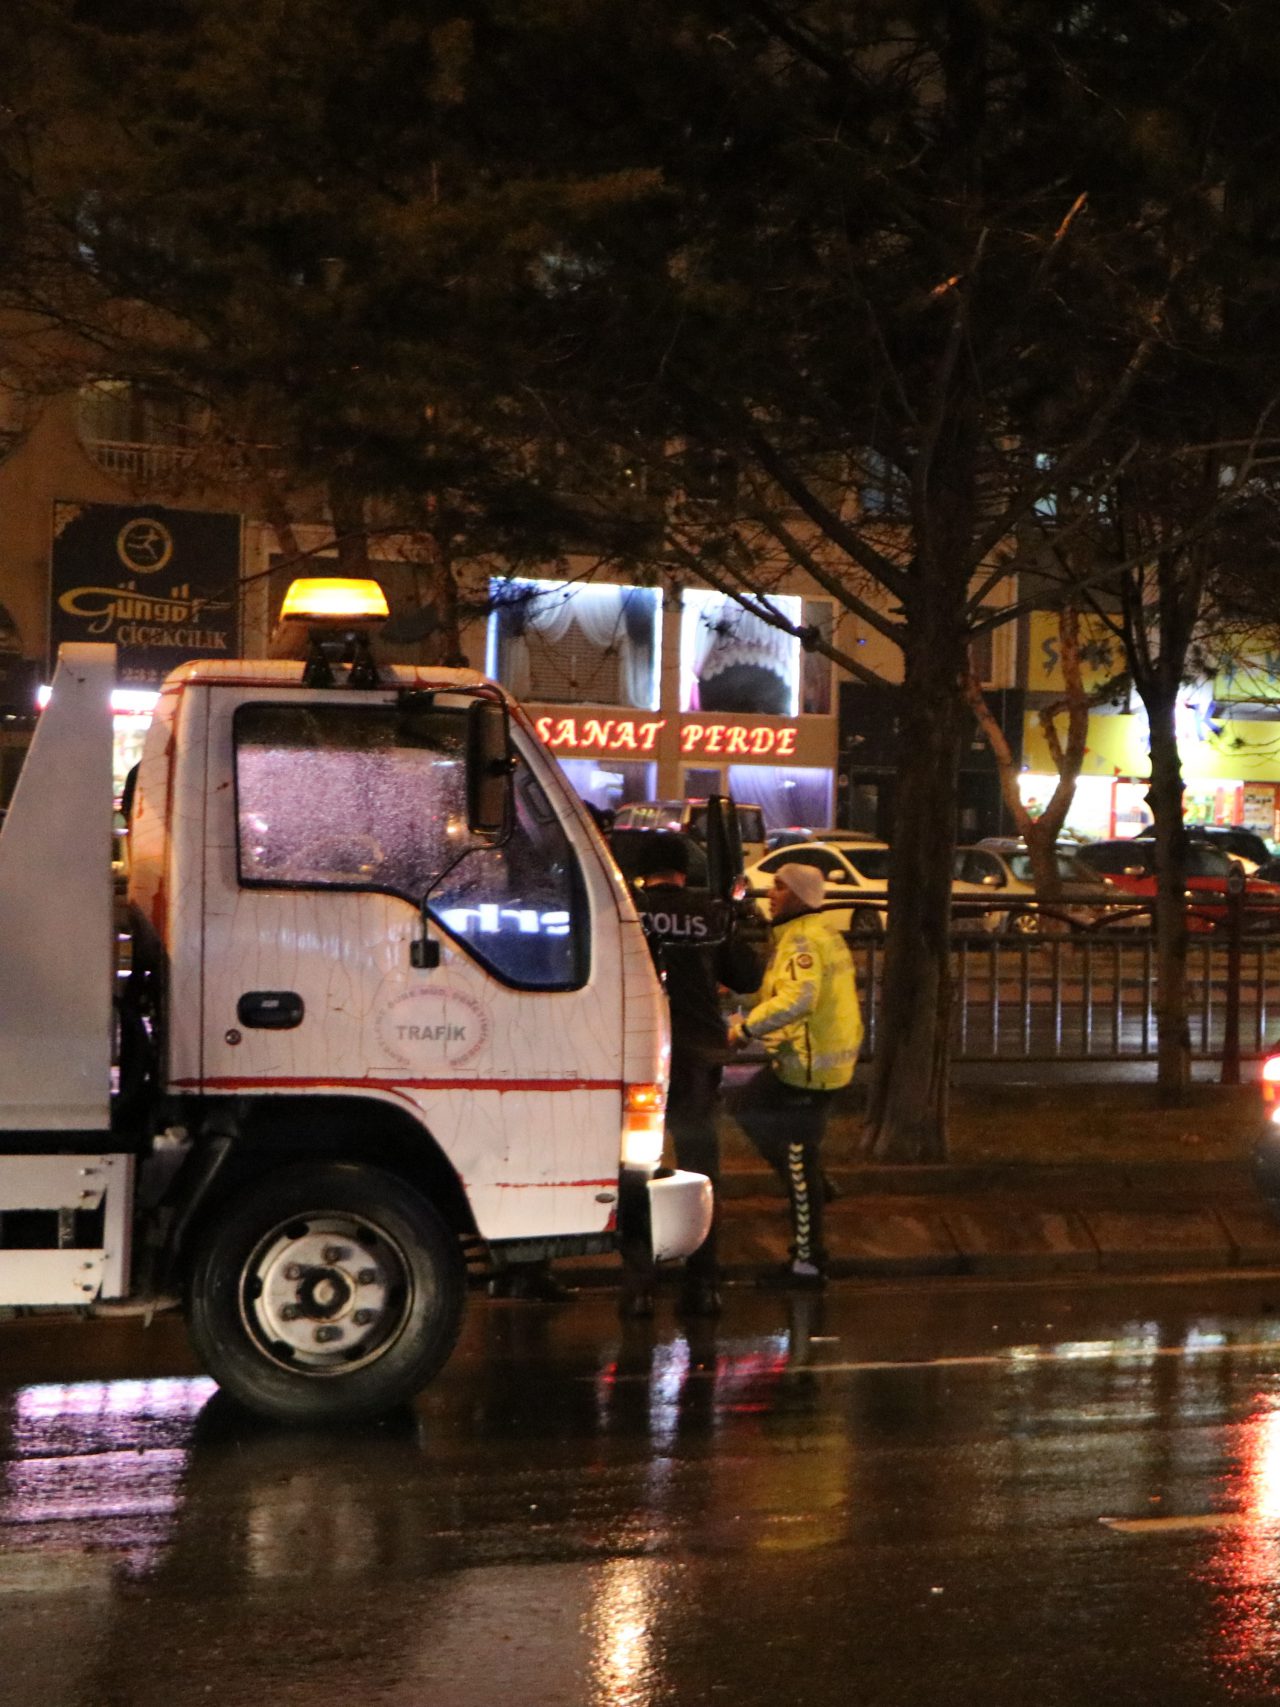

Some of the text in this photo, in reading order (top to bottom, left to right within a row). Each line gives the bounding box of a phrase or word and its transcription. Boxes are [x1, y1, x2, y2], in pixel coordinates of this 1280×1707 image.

[535, 716, 798, 756] SANAT PERDE
[396, 1023, 466, 1041] TRAFİK
